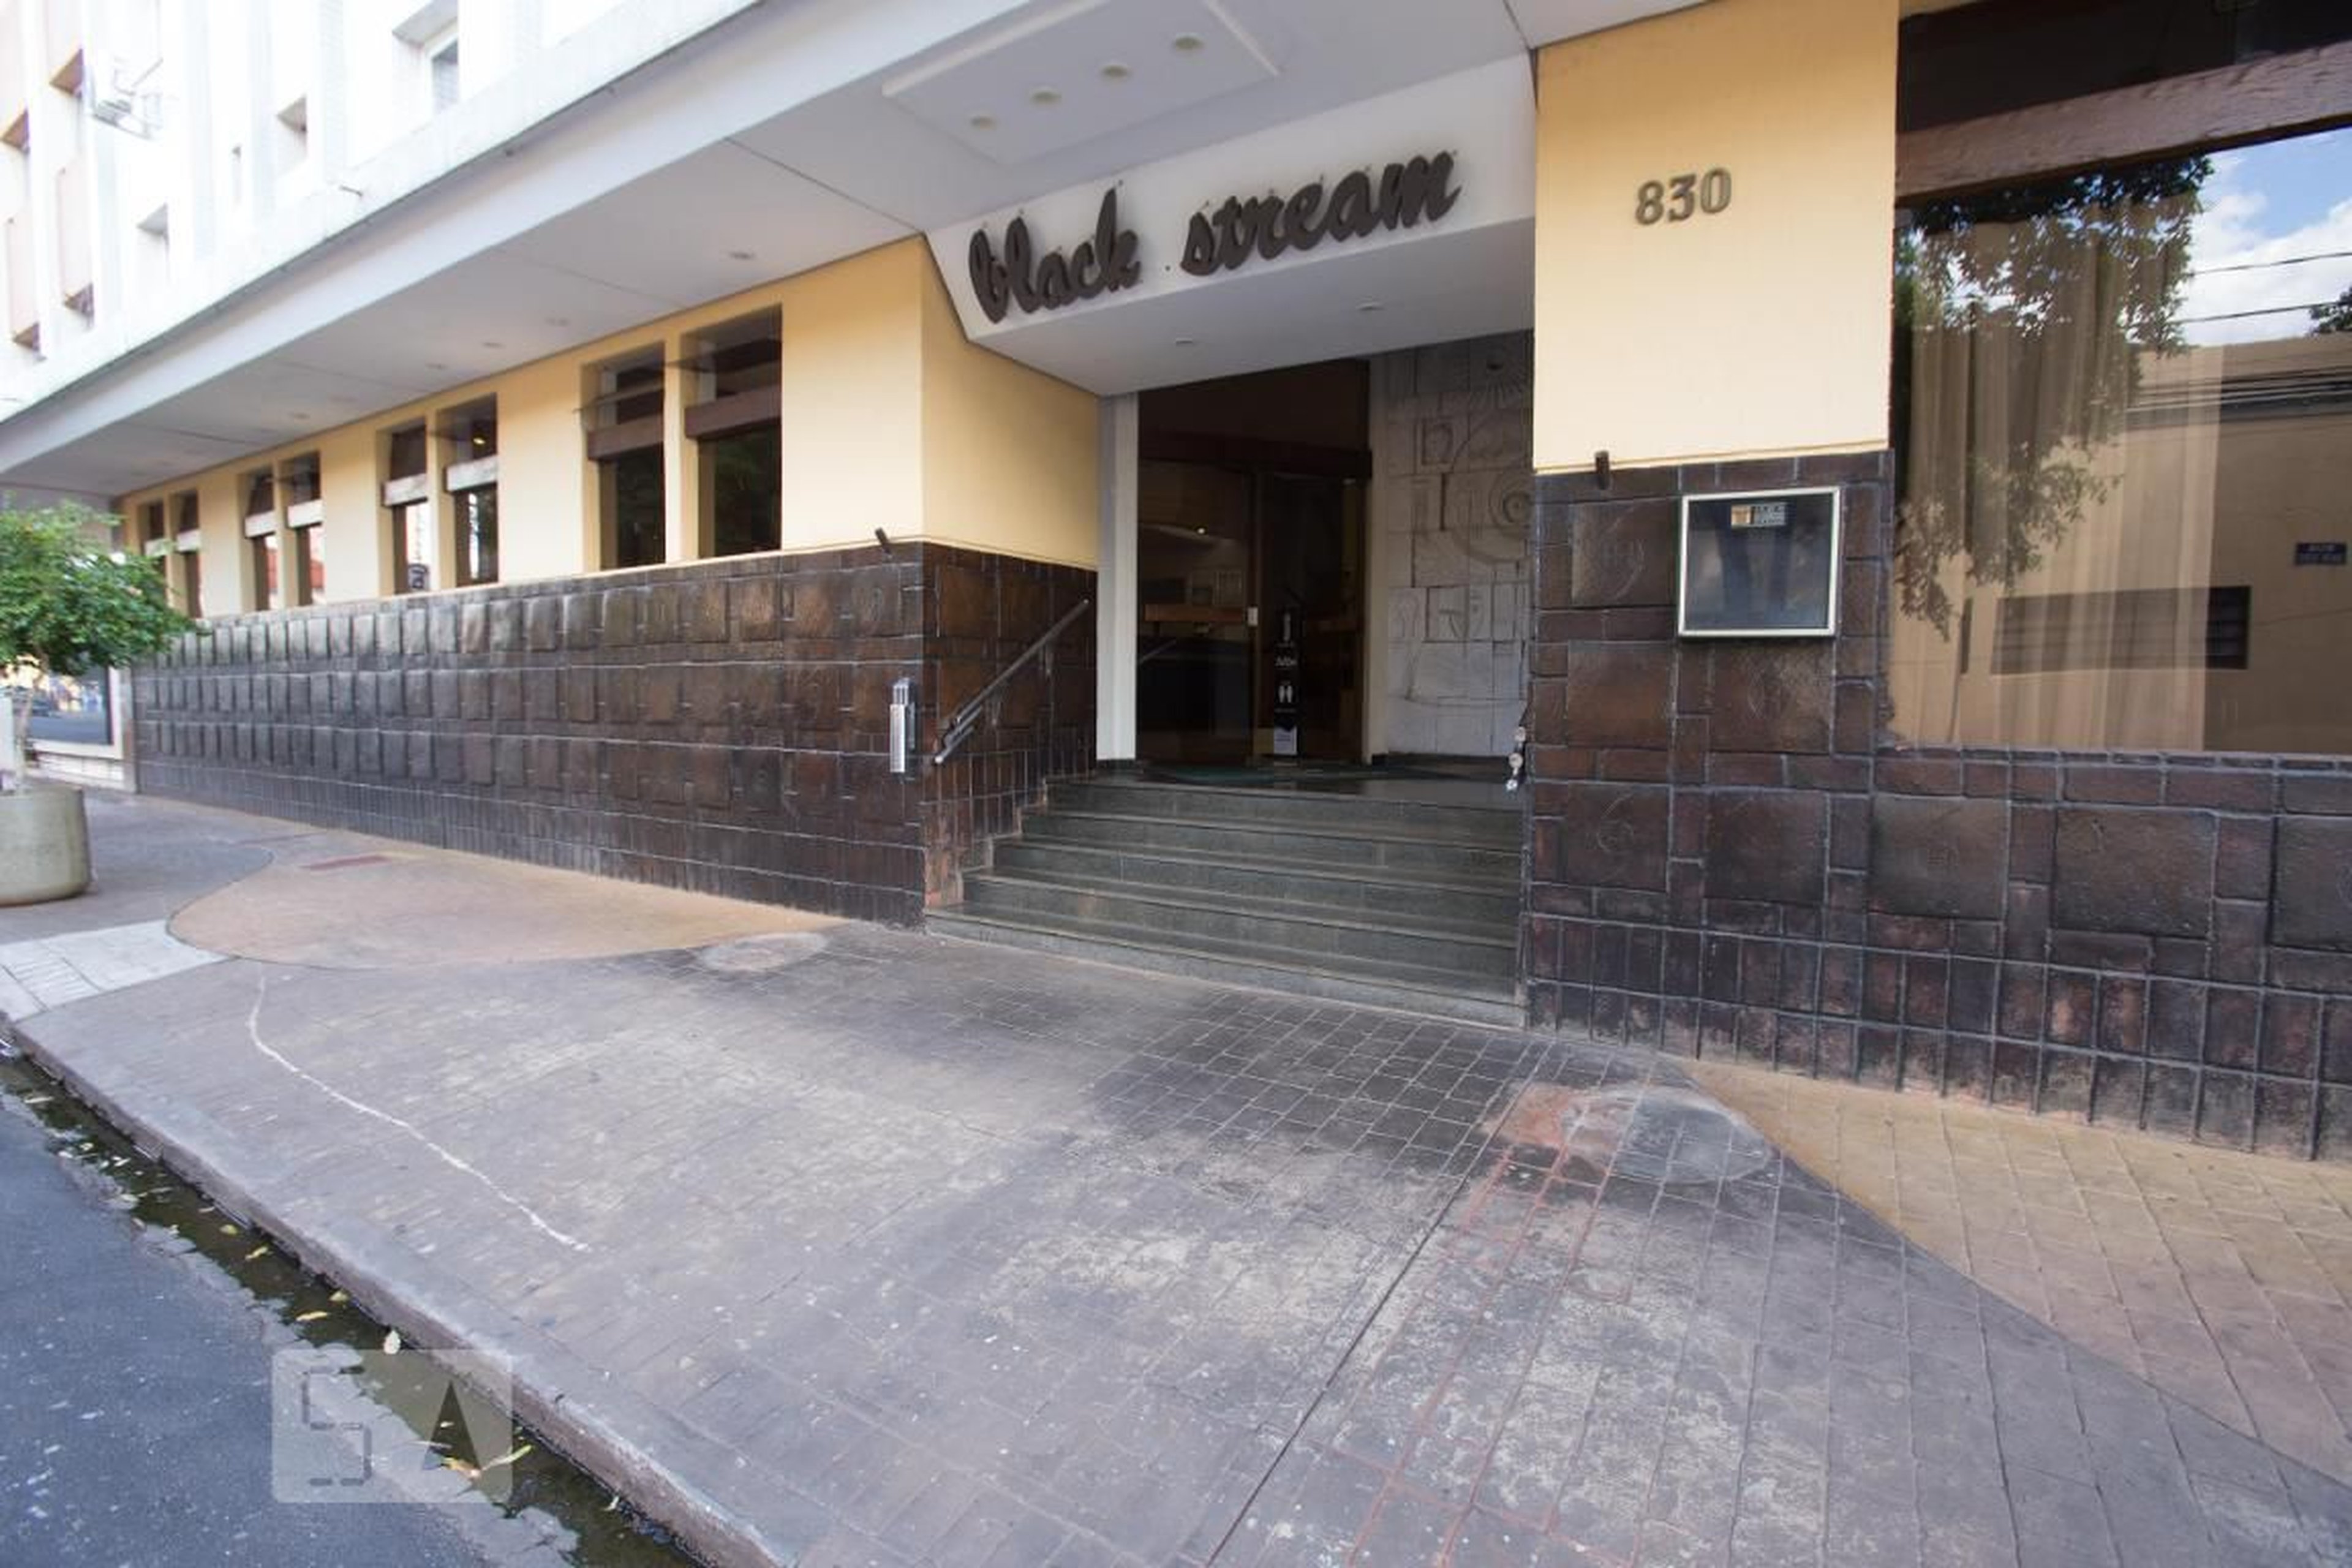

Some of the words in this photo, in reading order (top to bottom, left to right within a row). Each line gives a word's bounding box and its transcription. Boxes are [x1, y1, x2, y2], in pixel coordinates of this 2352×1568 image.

[969, 186, 1142, 323] black
[1180, 151, 1461, 276] stream
[1635, 168, 1732, 225] 830
